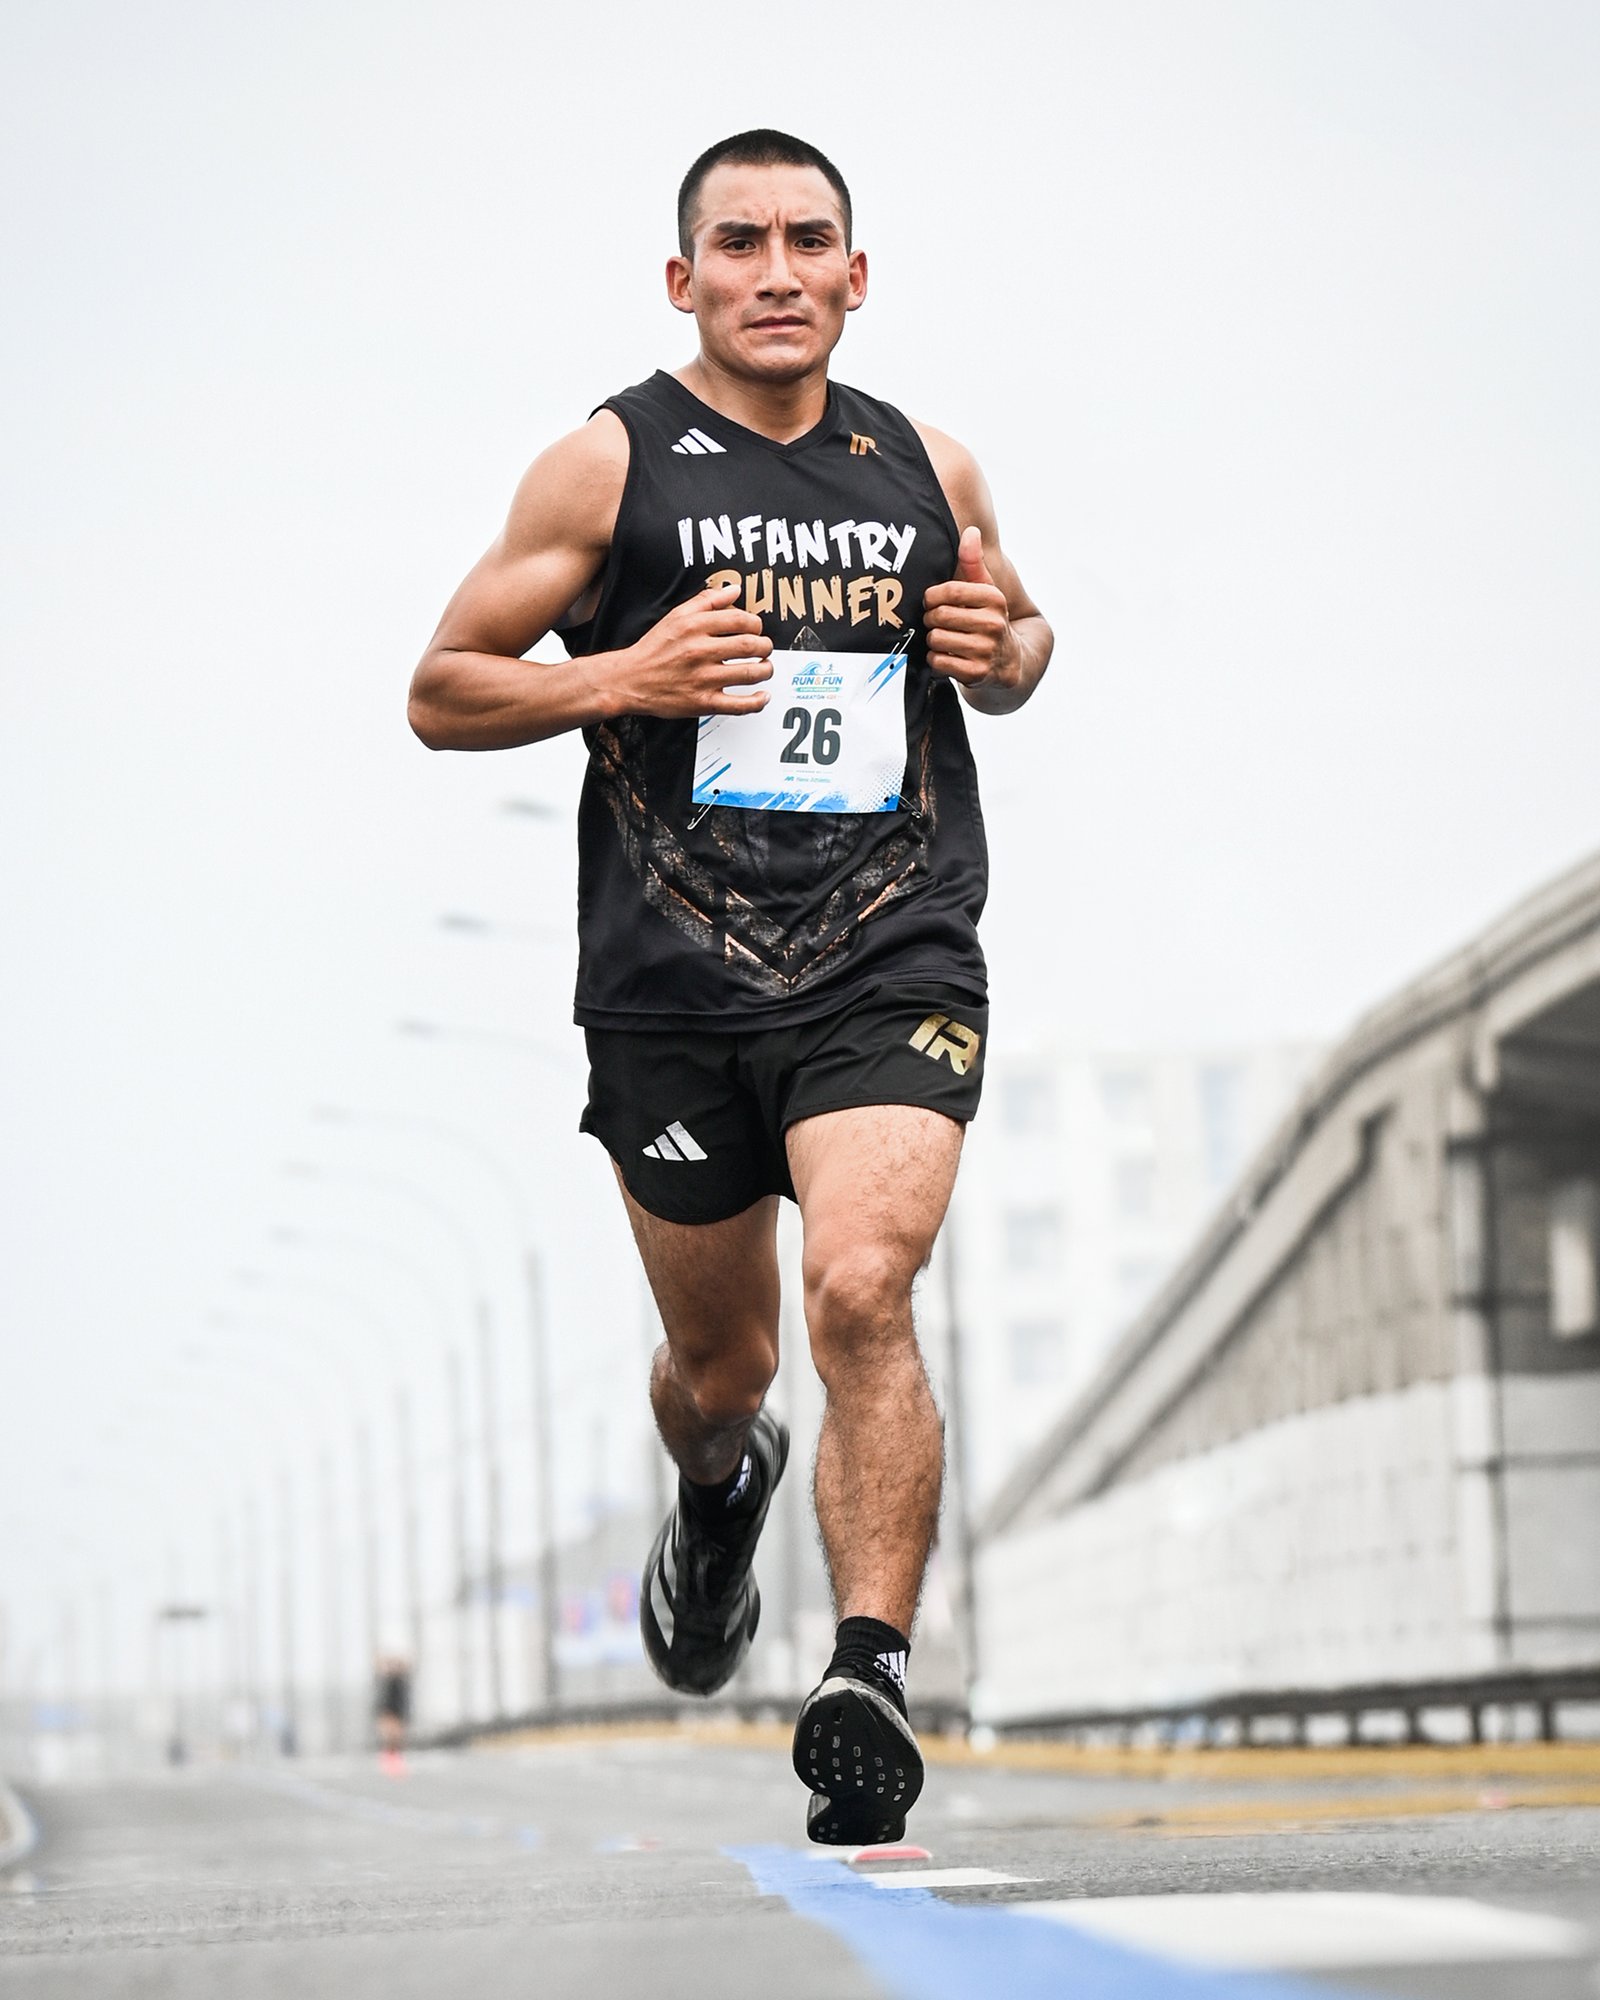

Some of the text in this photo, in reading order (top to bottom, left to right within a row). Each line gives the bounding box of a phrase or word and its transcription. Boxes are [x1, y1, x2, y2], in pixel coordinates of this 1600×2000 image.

[677, 514, 917, 574] INFANTRY
[780, 706, 842, 766] 26
[908, 1012, 981, 1076] IR
